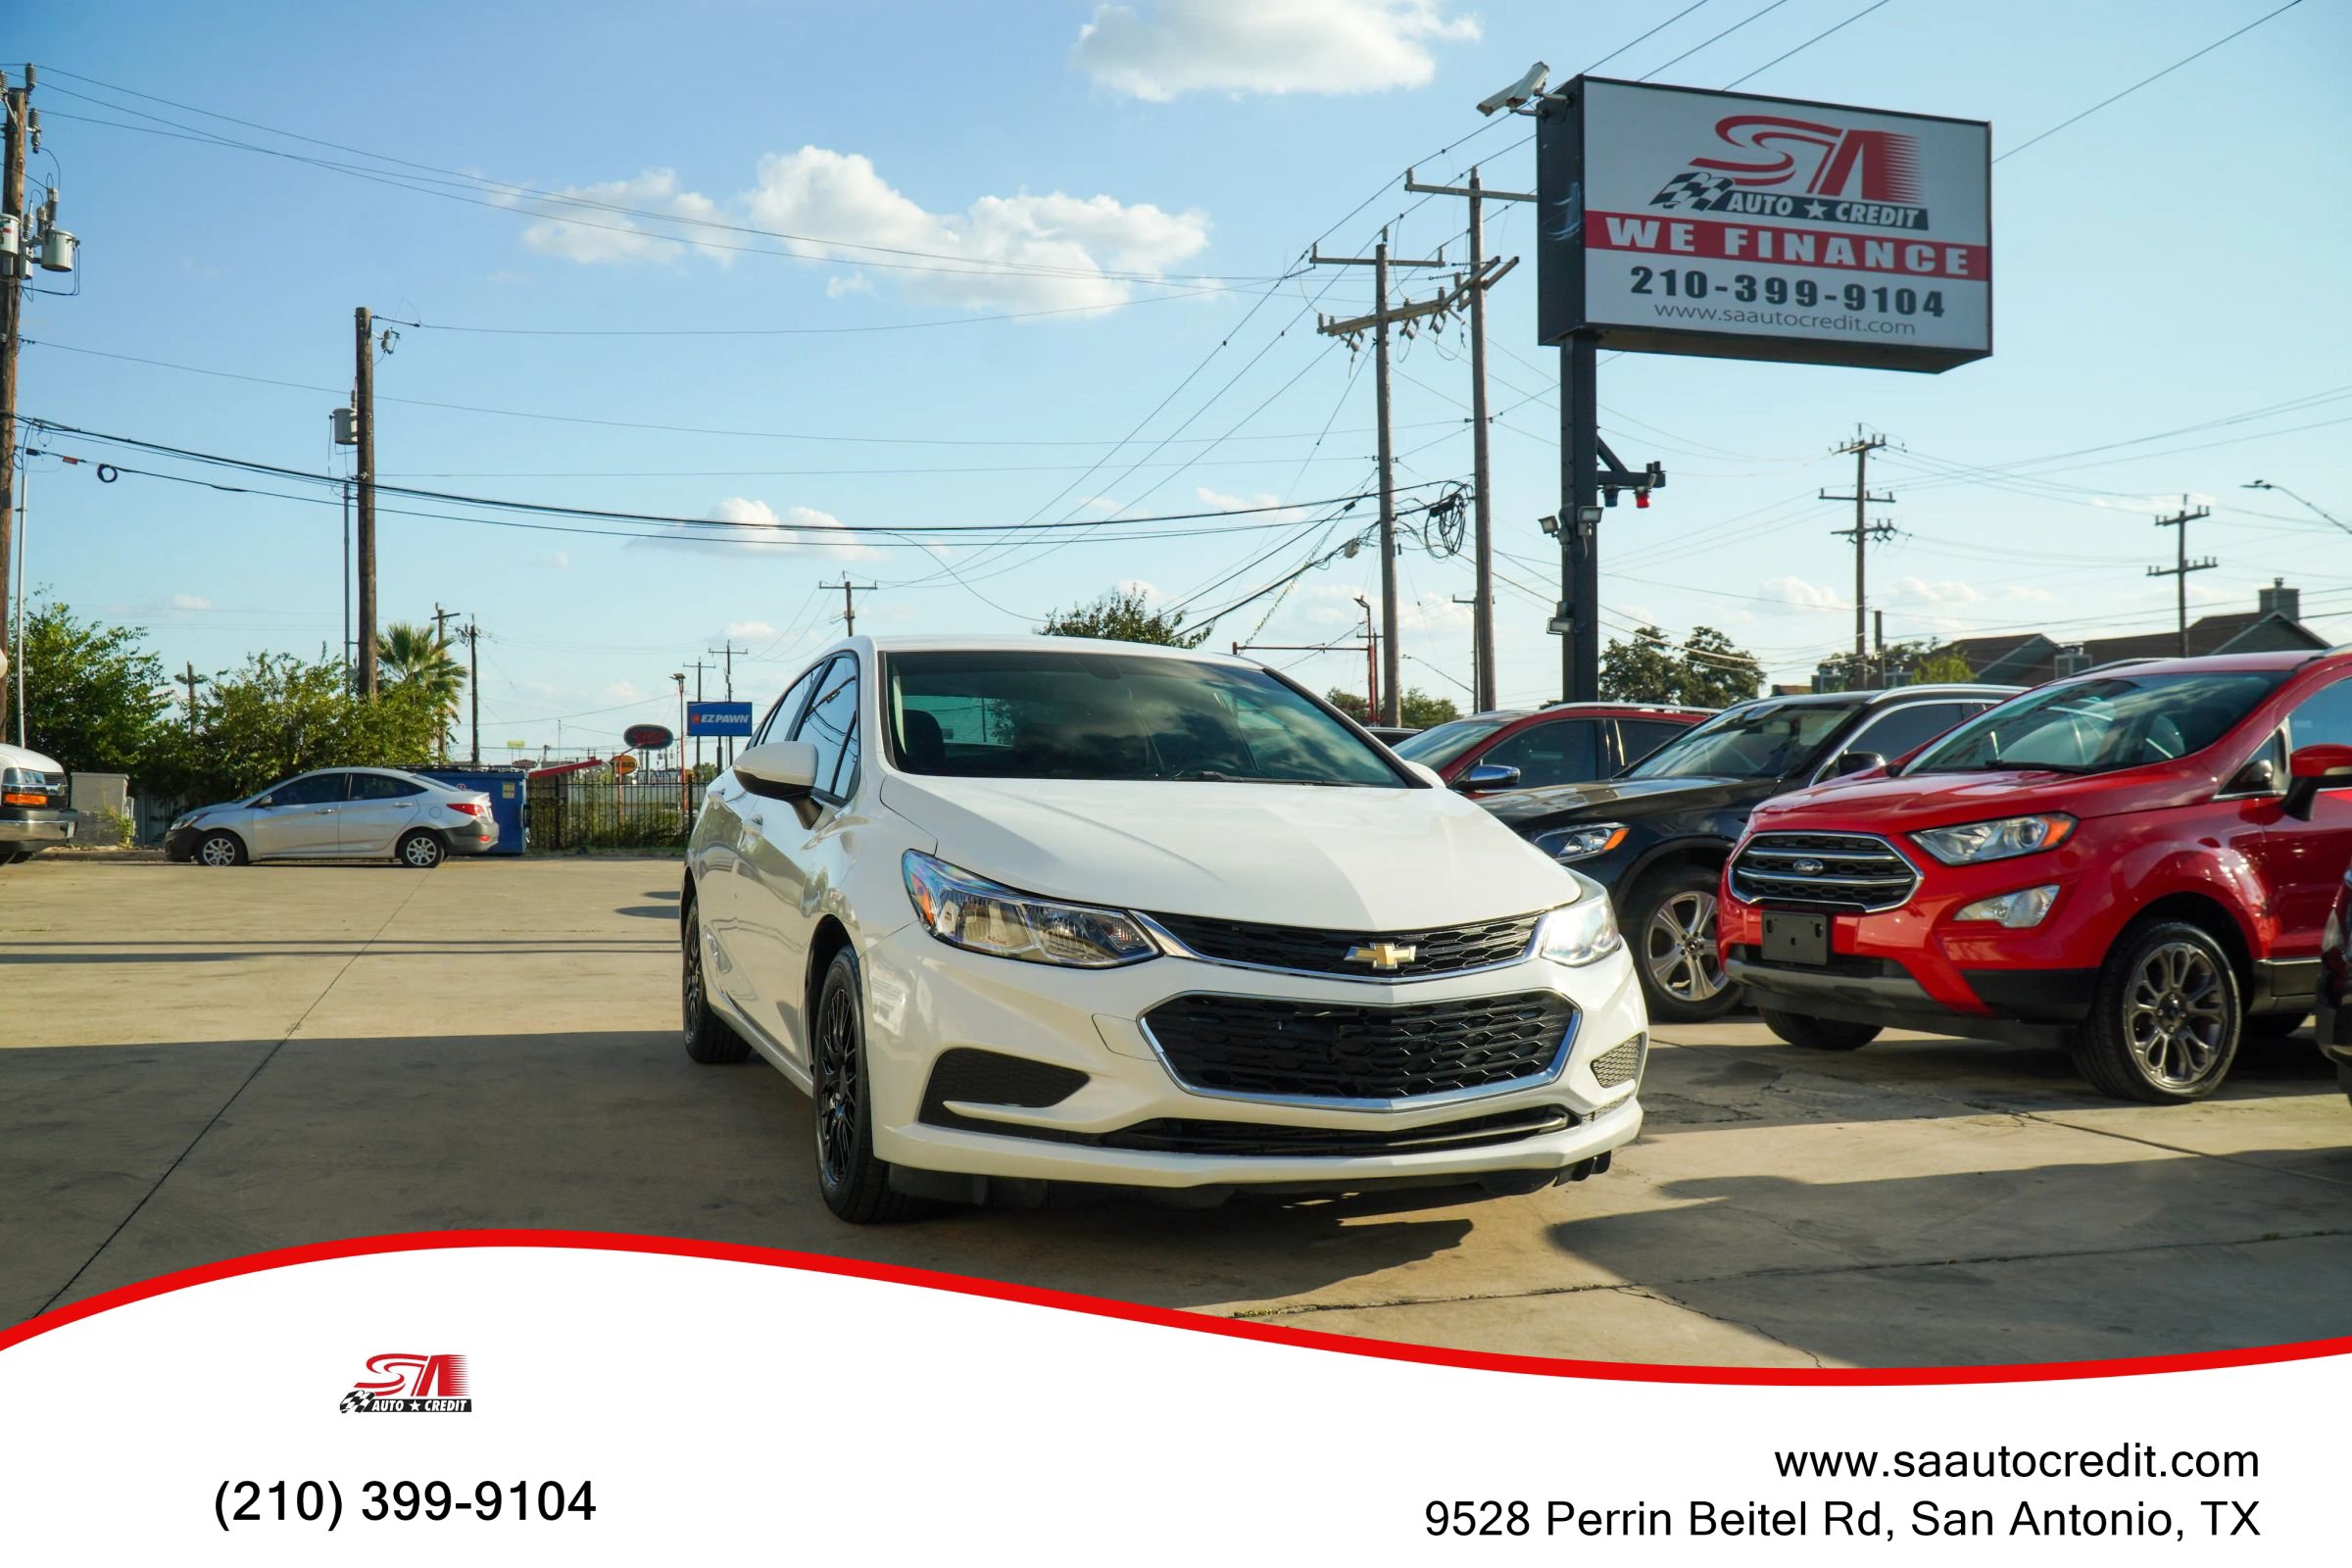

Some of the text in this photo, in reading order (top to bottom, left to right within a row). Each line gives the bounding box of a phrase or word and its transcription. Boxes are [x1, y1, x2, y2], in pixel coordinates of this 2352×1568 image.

[1726, 192, 1920, 228] AUTO CREDIT
[1606, 217, 1969, 275] WE FINANCE
[1630, 266, 1945, 318] 210-399-9104
[1654, 303, 1916, 336] www.saautocredit.com
